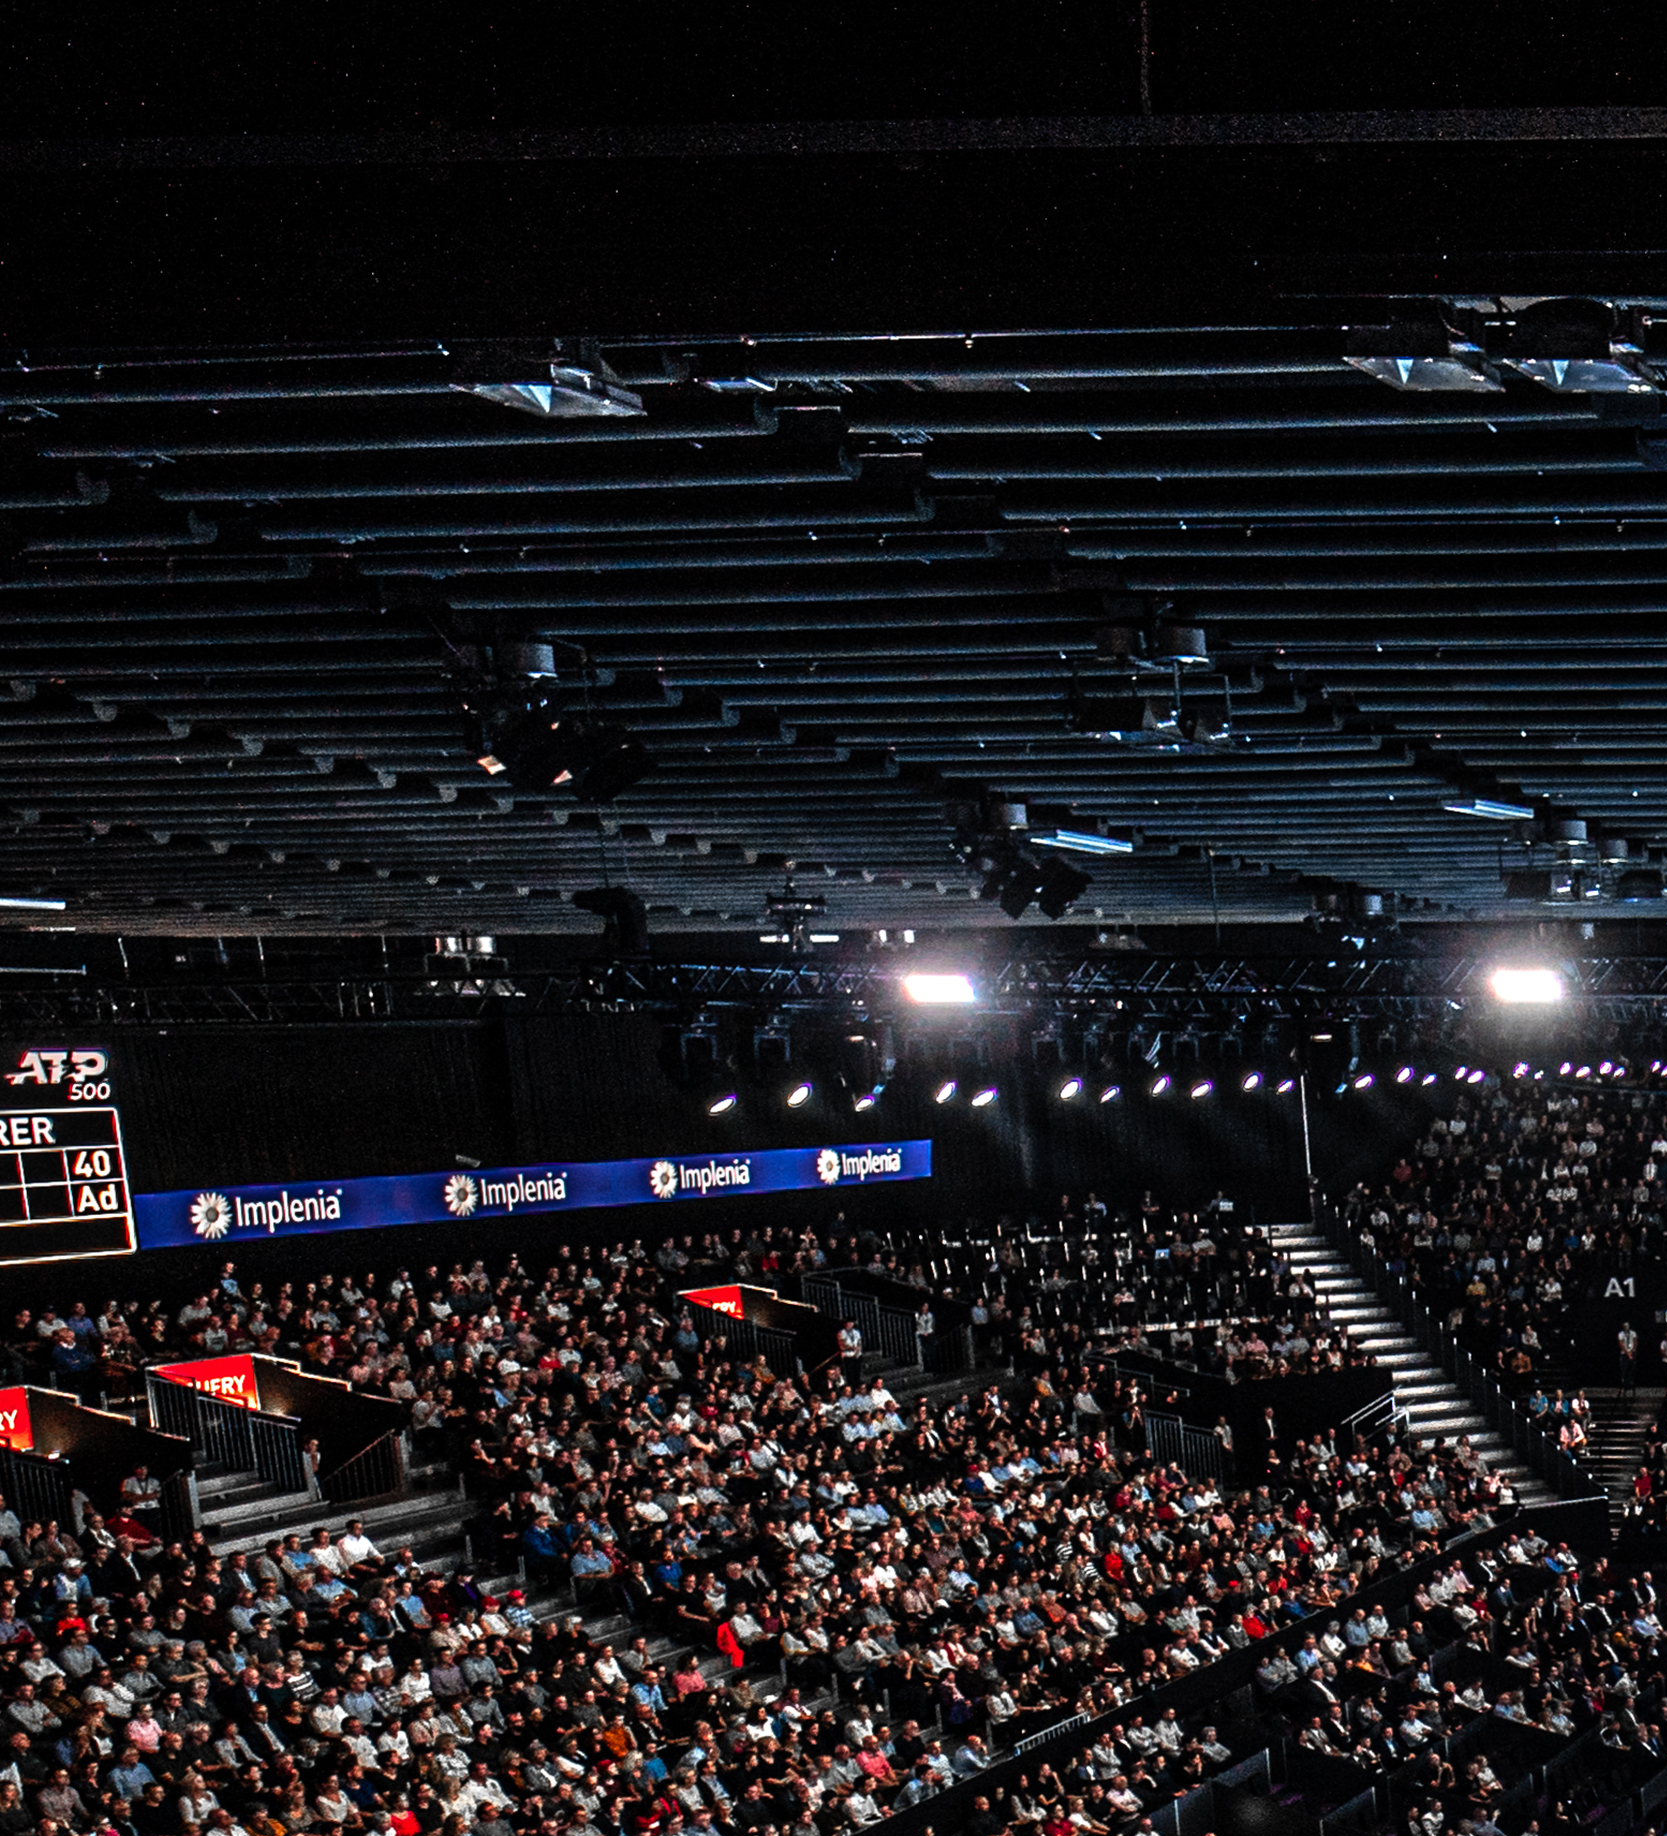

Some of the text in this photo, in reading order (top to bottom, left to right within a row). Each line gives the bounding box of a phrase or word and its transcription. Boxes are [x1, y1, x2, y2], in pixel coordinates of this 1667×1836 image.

[5, 1050, 108, 1084] ATP
[69, 1082, 111, 1100] 500
[74, 1150, 111, 1178] 40
[680, 1158, 750, 1194] Implenia
[842, 1148, 902, 1181] Implenia
[78, 1183, 119, 1213] Ad
[481, 1173, 567, 1212] Implenia
[235, 1188, 342, 1233] Implenia
[1603, 1276, 1636, 1298] A1
